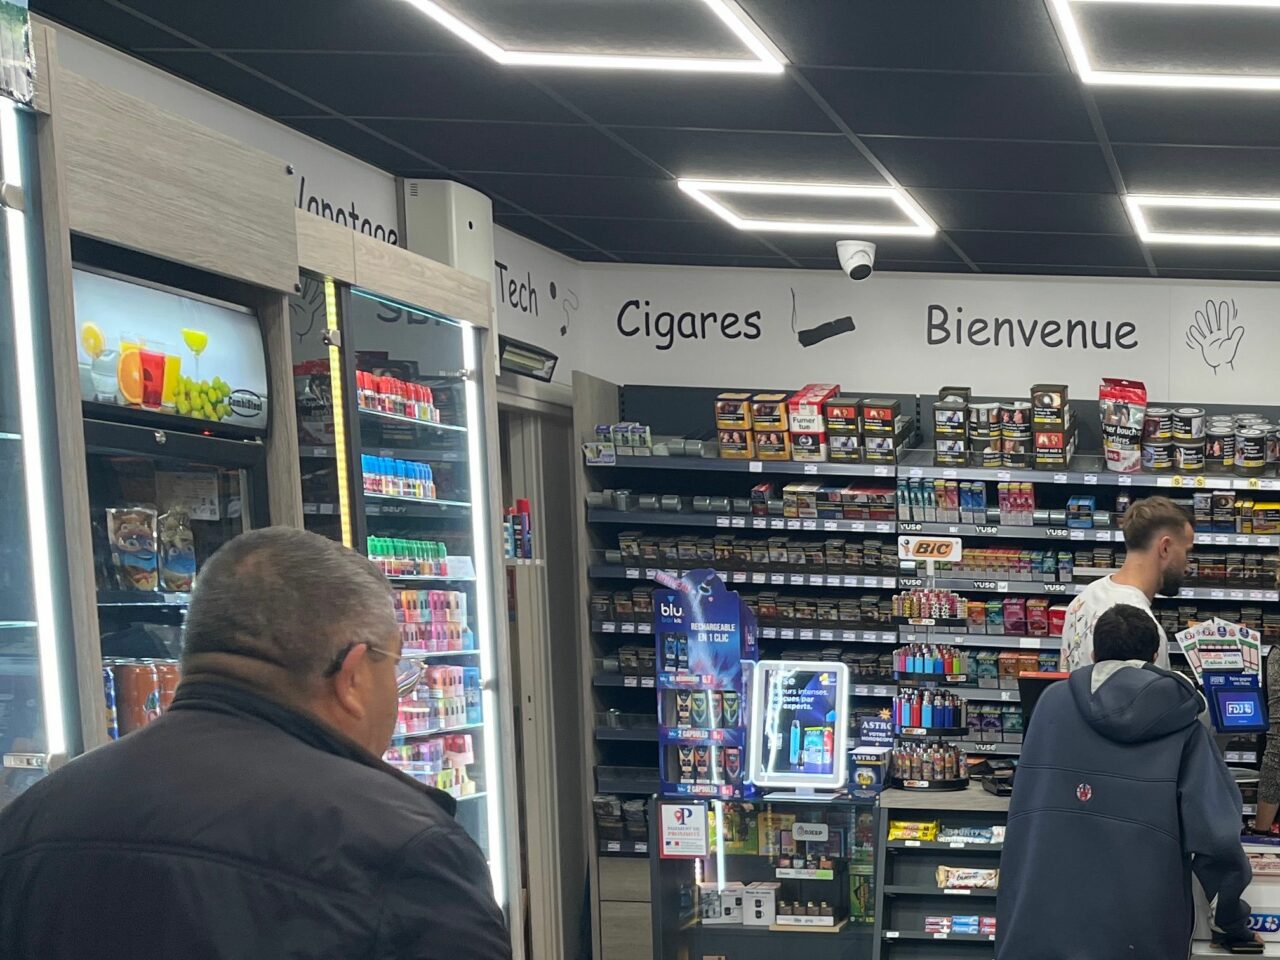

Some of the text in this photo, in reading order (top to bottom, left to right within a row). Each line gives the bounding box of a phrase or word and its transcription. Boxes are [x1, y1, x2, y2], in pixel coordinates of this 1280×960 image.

[495, 262, 539, 316] Tech
[616, 300, 763, 350] Cigares
[926, 303, 1139, 350] Bienvenue
[691, 623, 735, 632] RECHARGEABLE
[698, 633, 707, 642] EN
[714, 633, 730, 642] CLIC
[1228, 703, 1244, 714] FDJ
